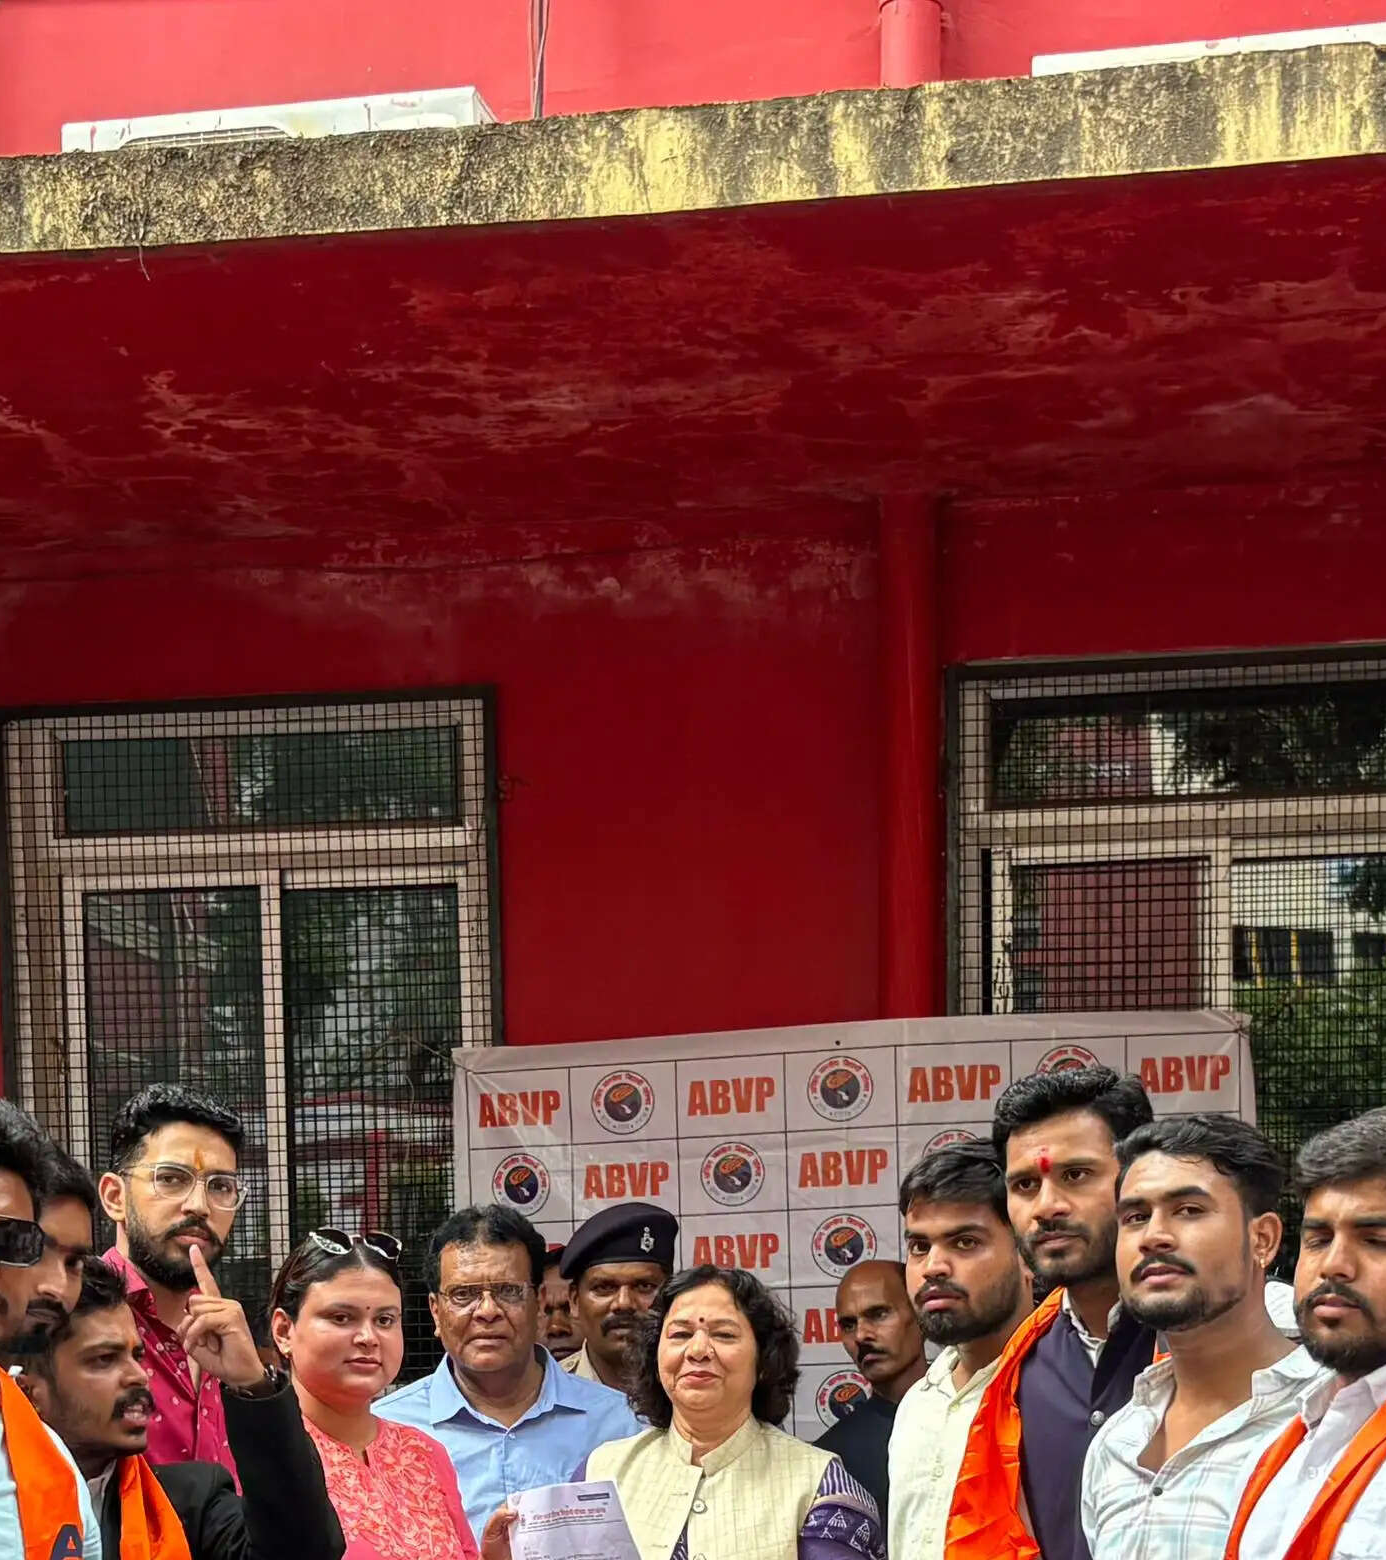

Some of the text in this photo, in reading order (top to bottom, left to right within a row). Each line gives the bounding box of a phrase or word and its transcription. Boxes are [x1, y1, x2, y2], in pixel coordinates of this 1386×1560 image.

[907, 1064, 1001, 1104] ABVP
[1140, 1054, 1231, 1094] ABVP
[479, 1090, 561, 1129] ABVP
[687, 1076, 775, 1117] ABVP
[583, 1160, 670, 1200] ABVP
[798, 1148, 889, 1188] ABVP
[693, 1232, 780, 1271] ABVP
